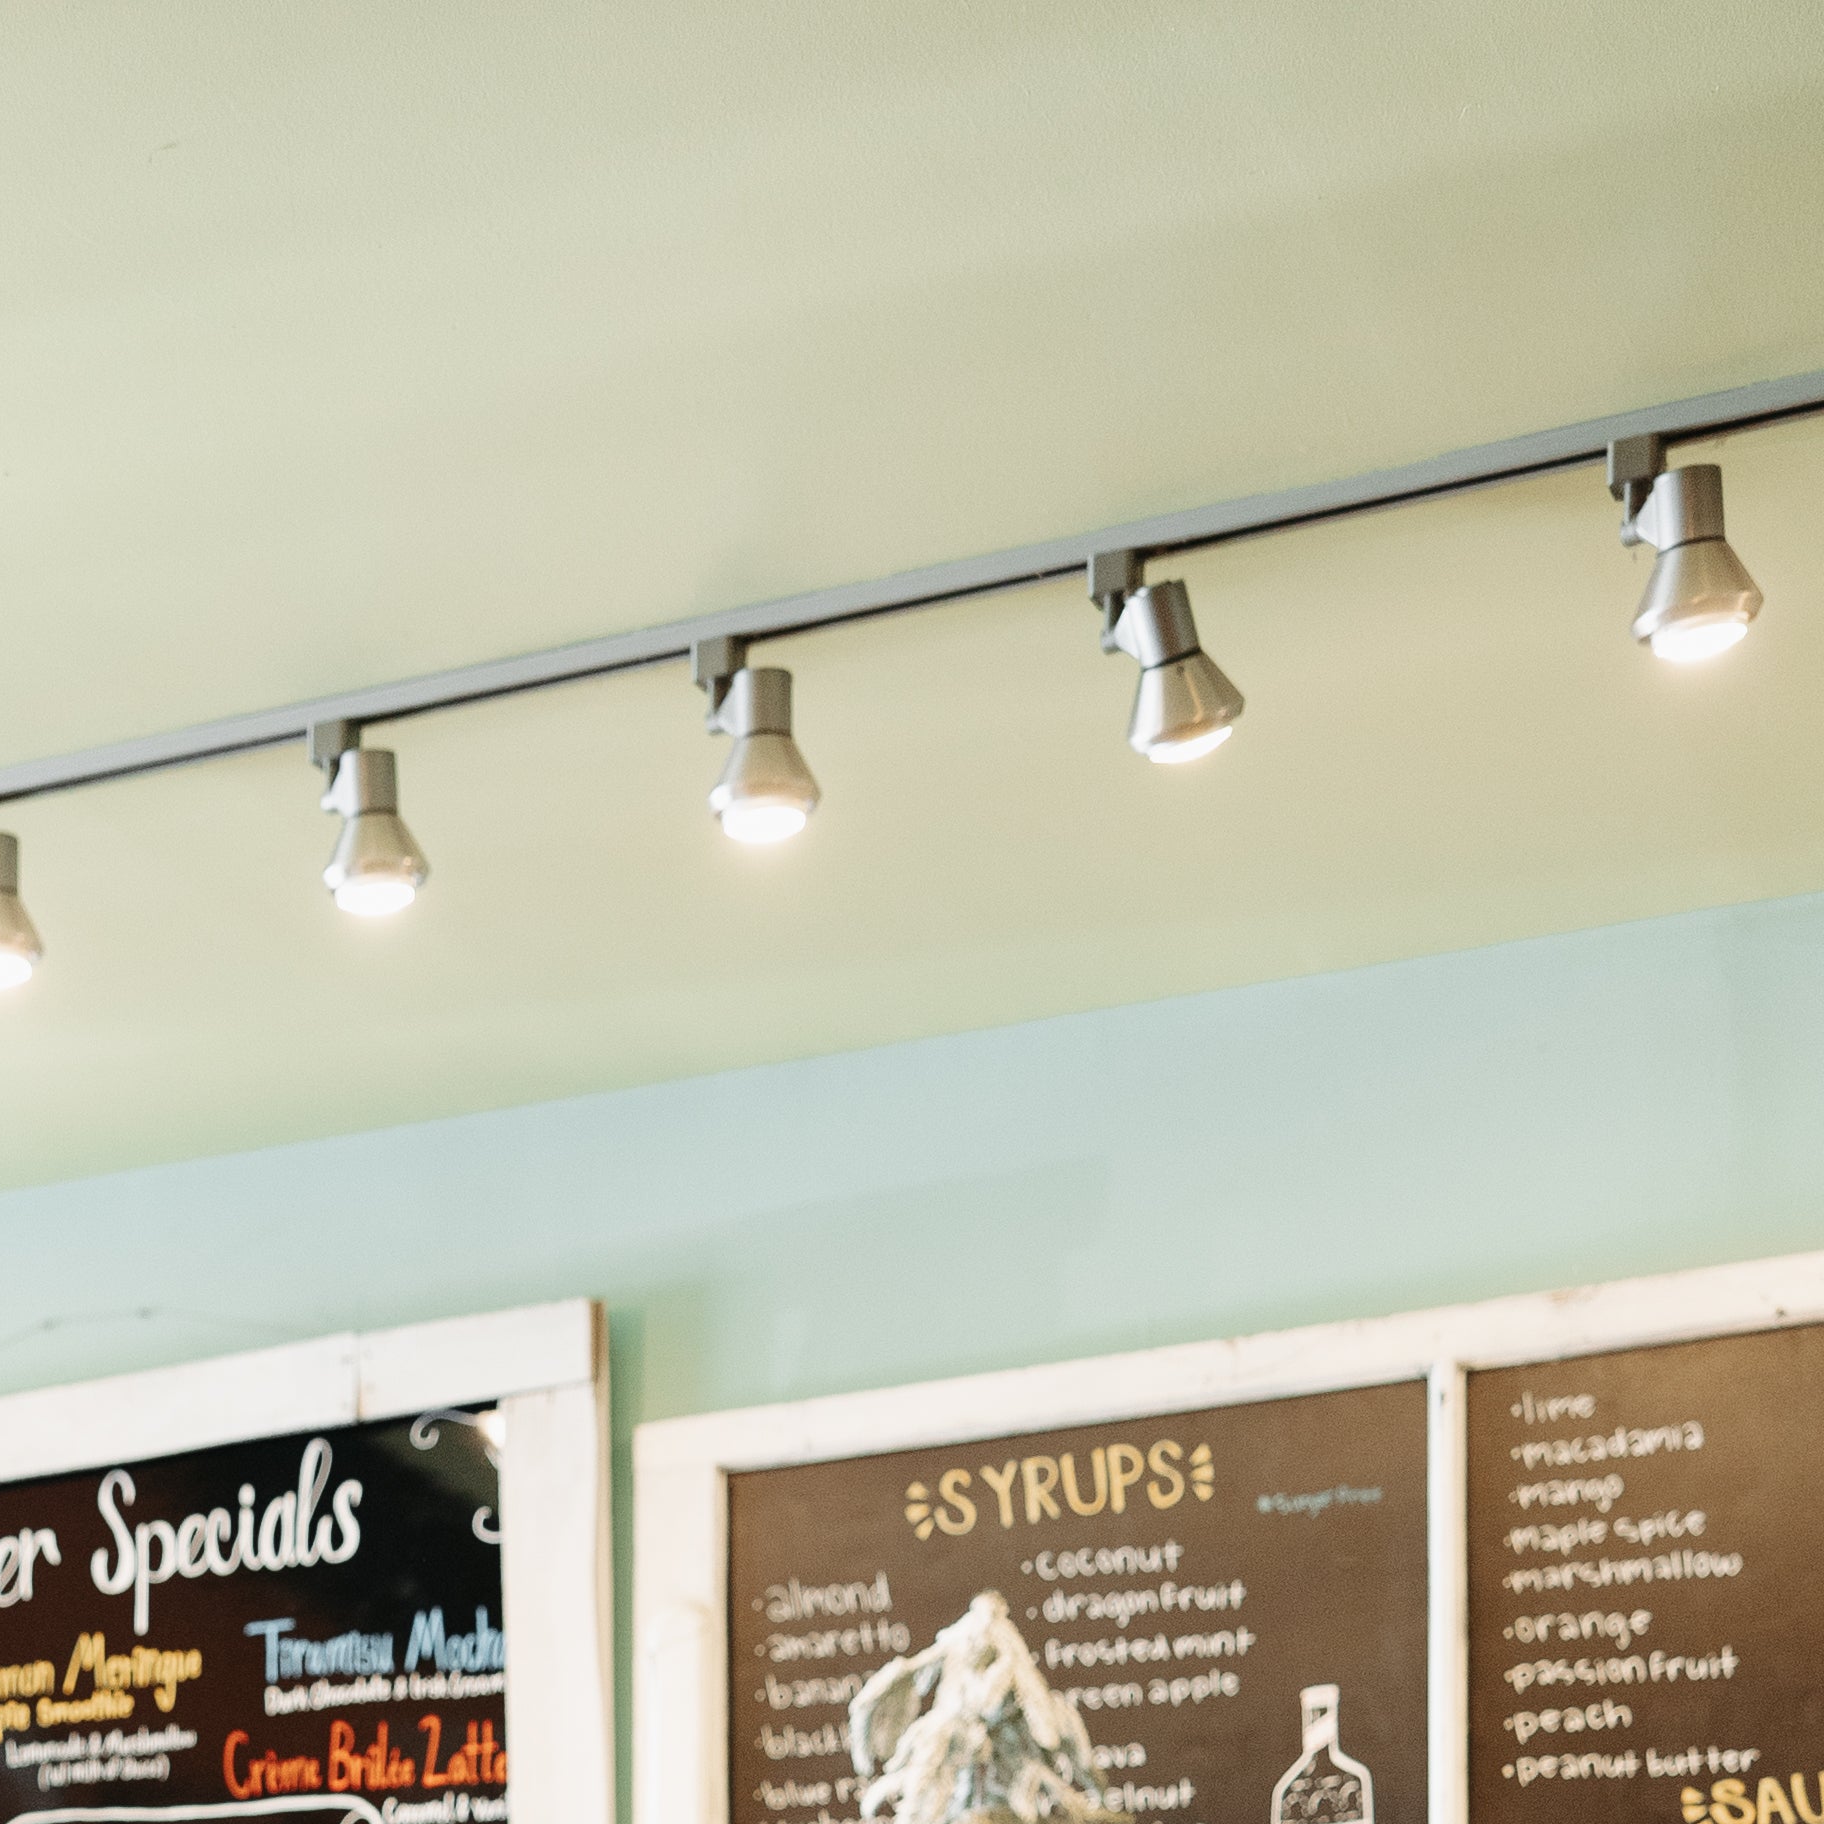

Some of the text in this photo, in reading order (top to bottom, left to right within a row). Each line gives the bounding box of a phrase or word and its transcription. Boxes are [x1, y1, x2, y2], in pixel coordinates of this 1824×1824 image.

[1521, 1389, 1597, 1426] lime
[1521, 1419, 1705, 1471] macadamia
[933, 1439, 1186, 1537] SYRUPS
[1516, 1472, 1625, 1514] mango
[91, 1438, 363, 1635] Specials
[1509, 1508, 1707, 1556] maple spice
[1034, 1538, 1185, 1581] coconut
[1510, 1550, 1744, 1595] marshmallow
[764, 1568, 893, 1624] almond
[404, 1605, 506, 1674] Moch
[764, 1616, 912, 1664] amaretto
[1044, 1624, 1257, 1670] frosted mint
[1513, 1608, 1654, 1651] orange
[64, 1633, 203, 1711] Meringue
[764, 1669, 876, 1712] banan
[1050, 1666, 1241, 1711] reen apple
[1512, 1697, 1634, 1746] peach
[1515, 1744, 1762, 1788] peanut butter
[760, 1779, 832, 1811] blue
